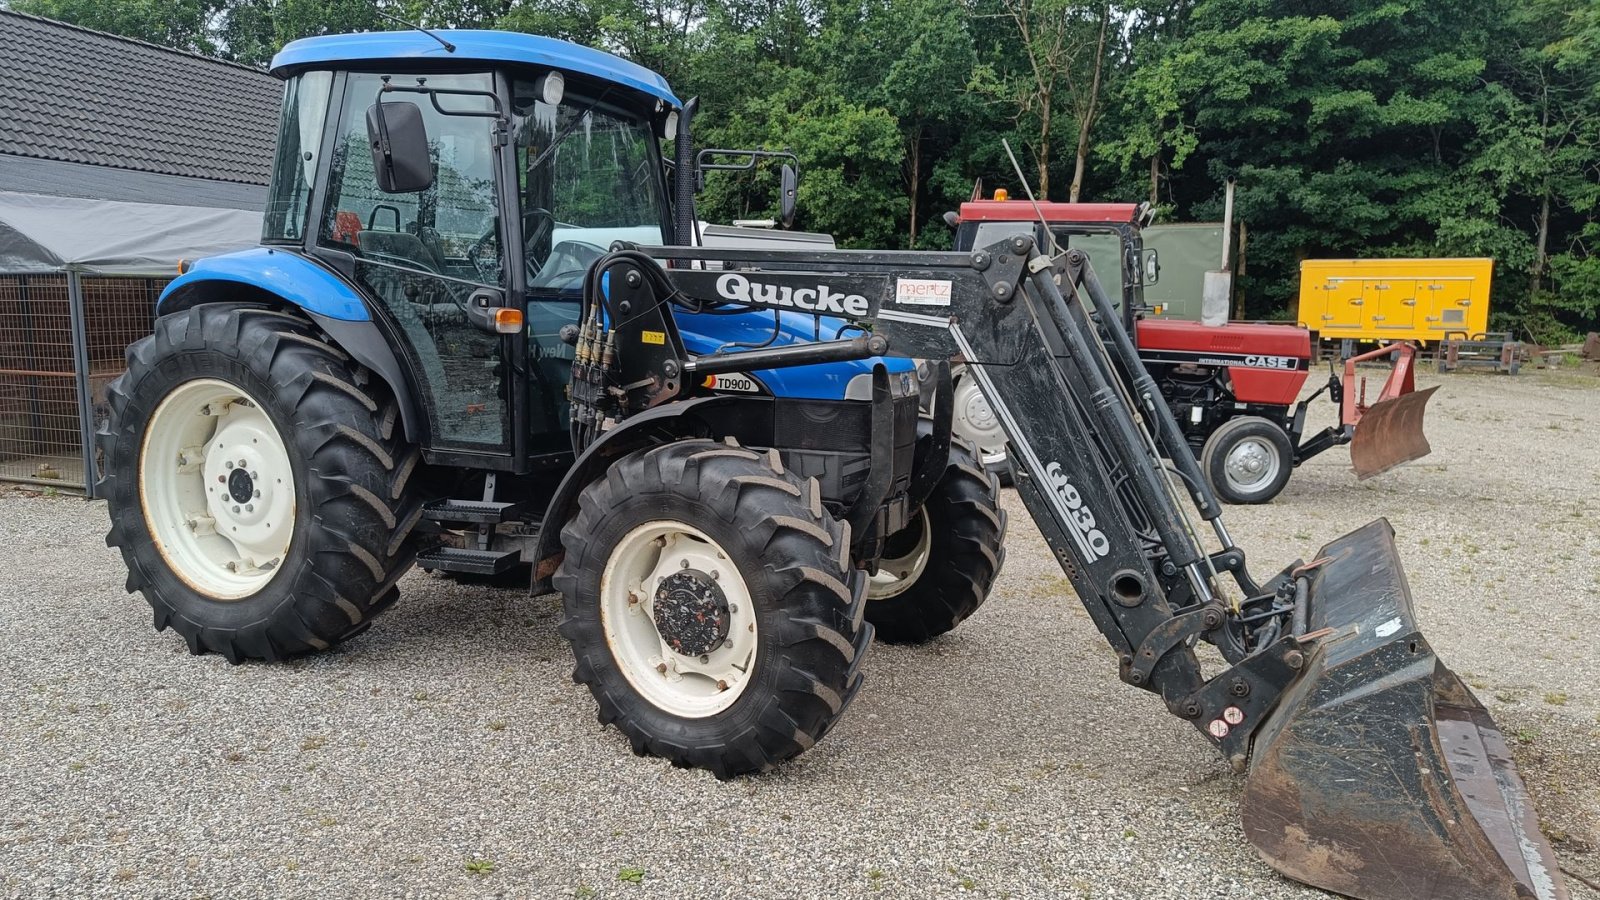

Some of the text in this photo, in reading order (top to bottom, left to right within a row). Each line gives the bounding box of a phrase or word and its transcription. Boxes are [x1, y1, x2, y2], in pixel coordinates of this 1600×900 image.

[716, 273, 869, 316] Quicke
[900, 283, 949, 296] mertz
[1199, 355, 1289, 369] INTERNATIONAL CASE
[718, 379, 752, 391] TD90D
[1046, 461, 1110, 556] Q930
